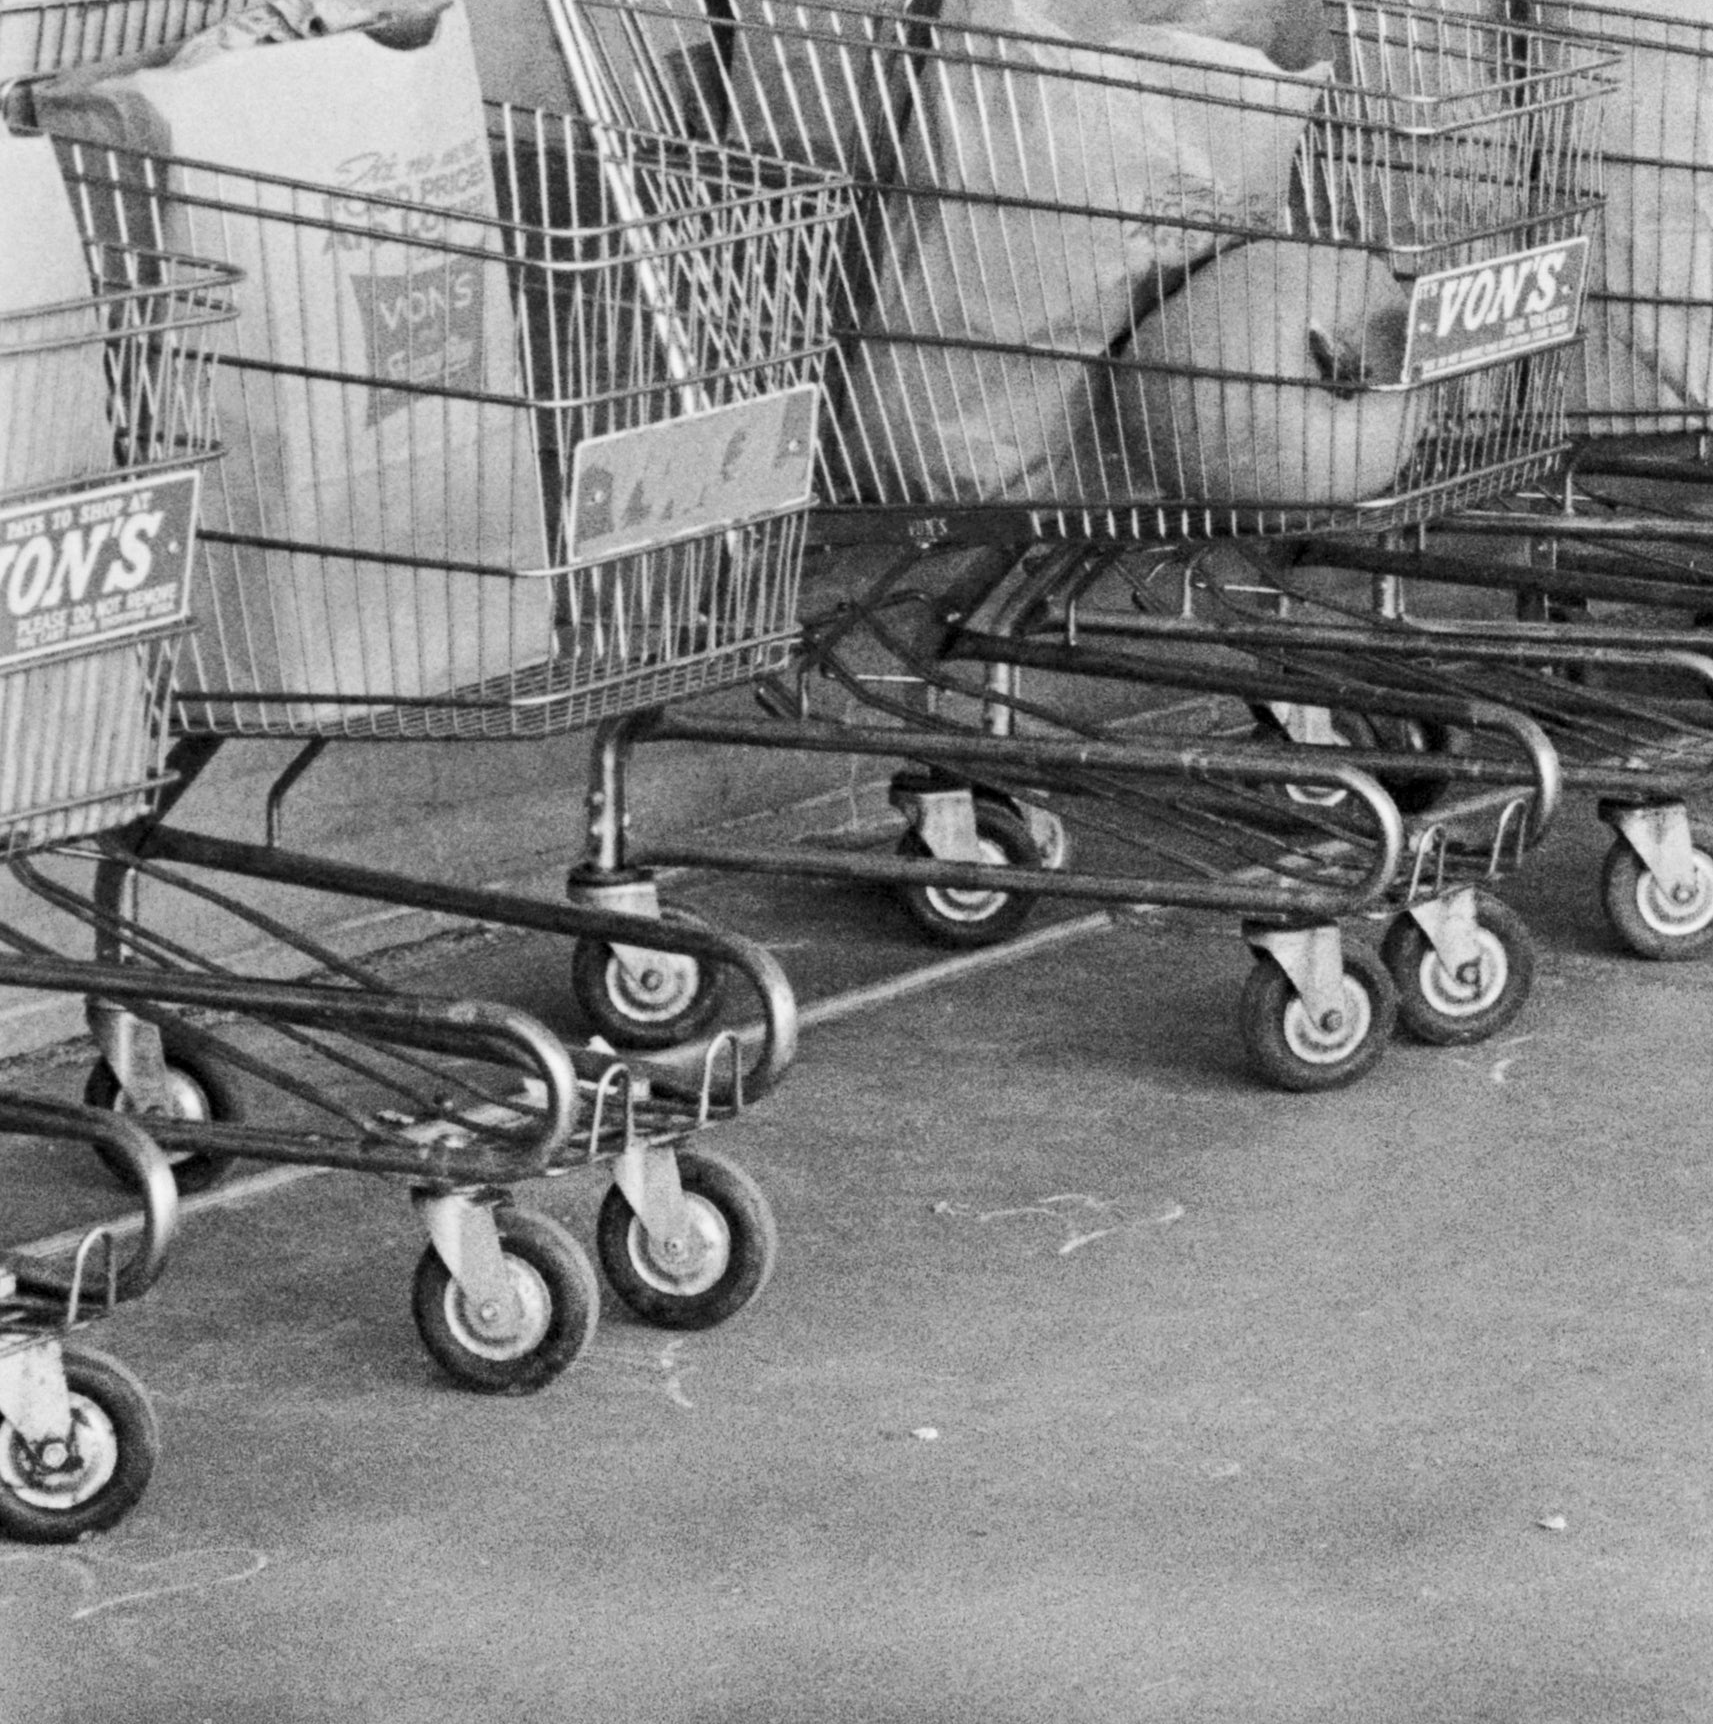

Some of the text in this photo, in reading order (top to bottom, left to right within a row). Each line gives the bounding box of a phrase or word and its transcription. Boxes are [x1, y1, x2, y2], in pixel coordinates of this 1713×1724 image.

[379, 272, 474, 330] VONS
[1437, 251, 1566, 337] VON'S
[51, 508, 73, 531] TO
[78, 498, 124, 524] SHOP
[127, 491, 153, 513] AT
[0, 510, 165, 616] ON'S
